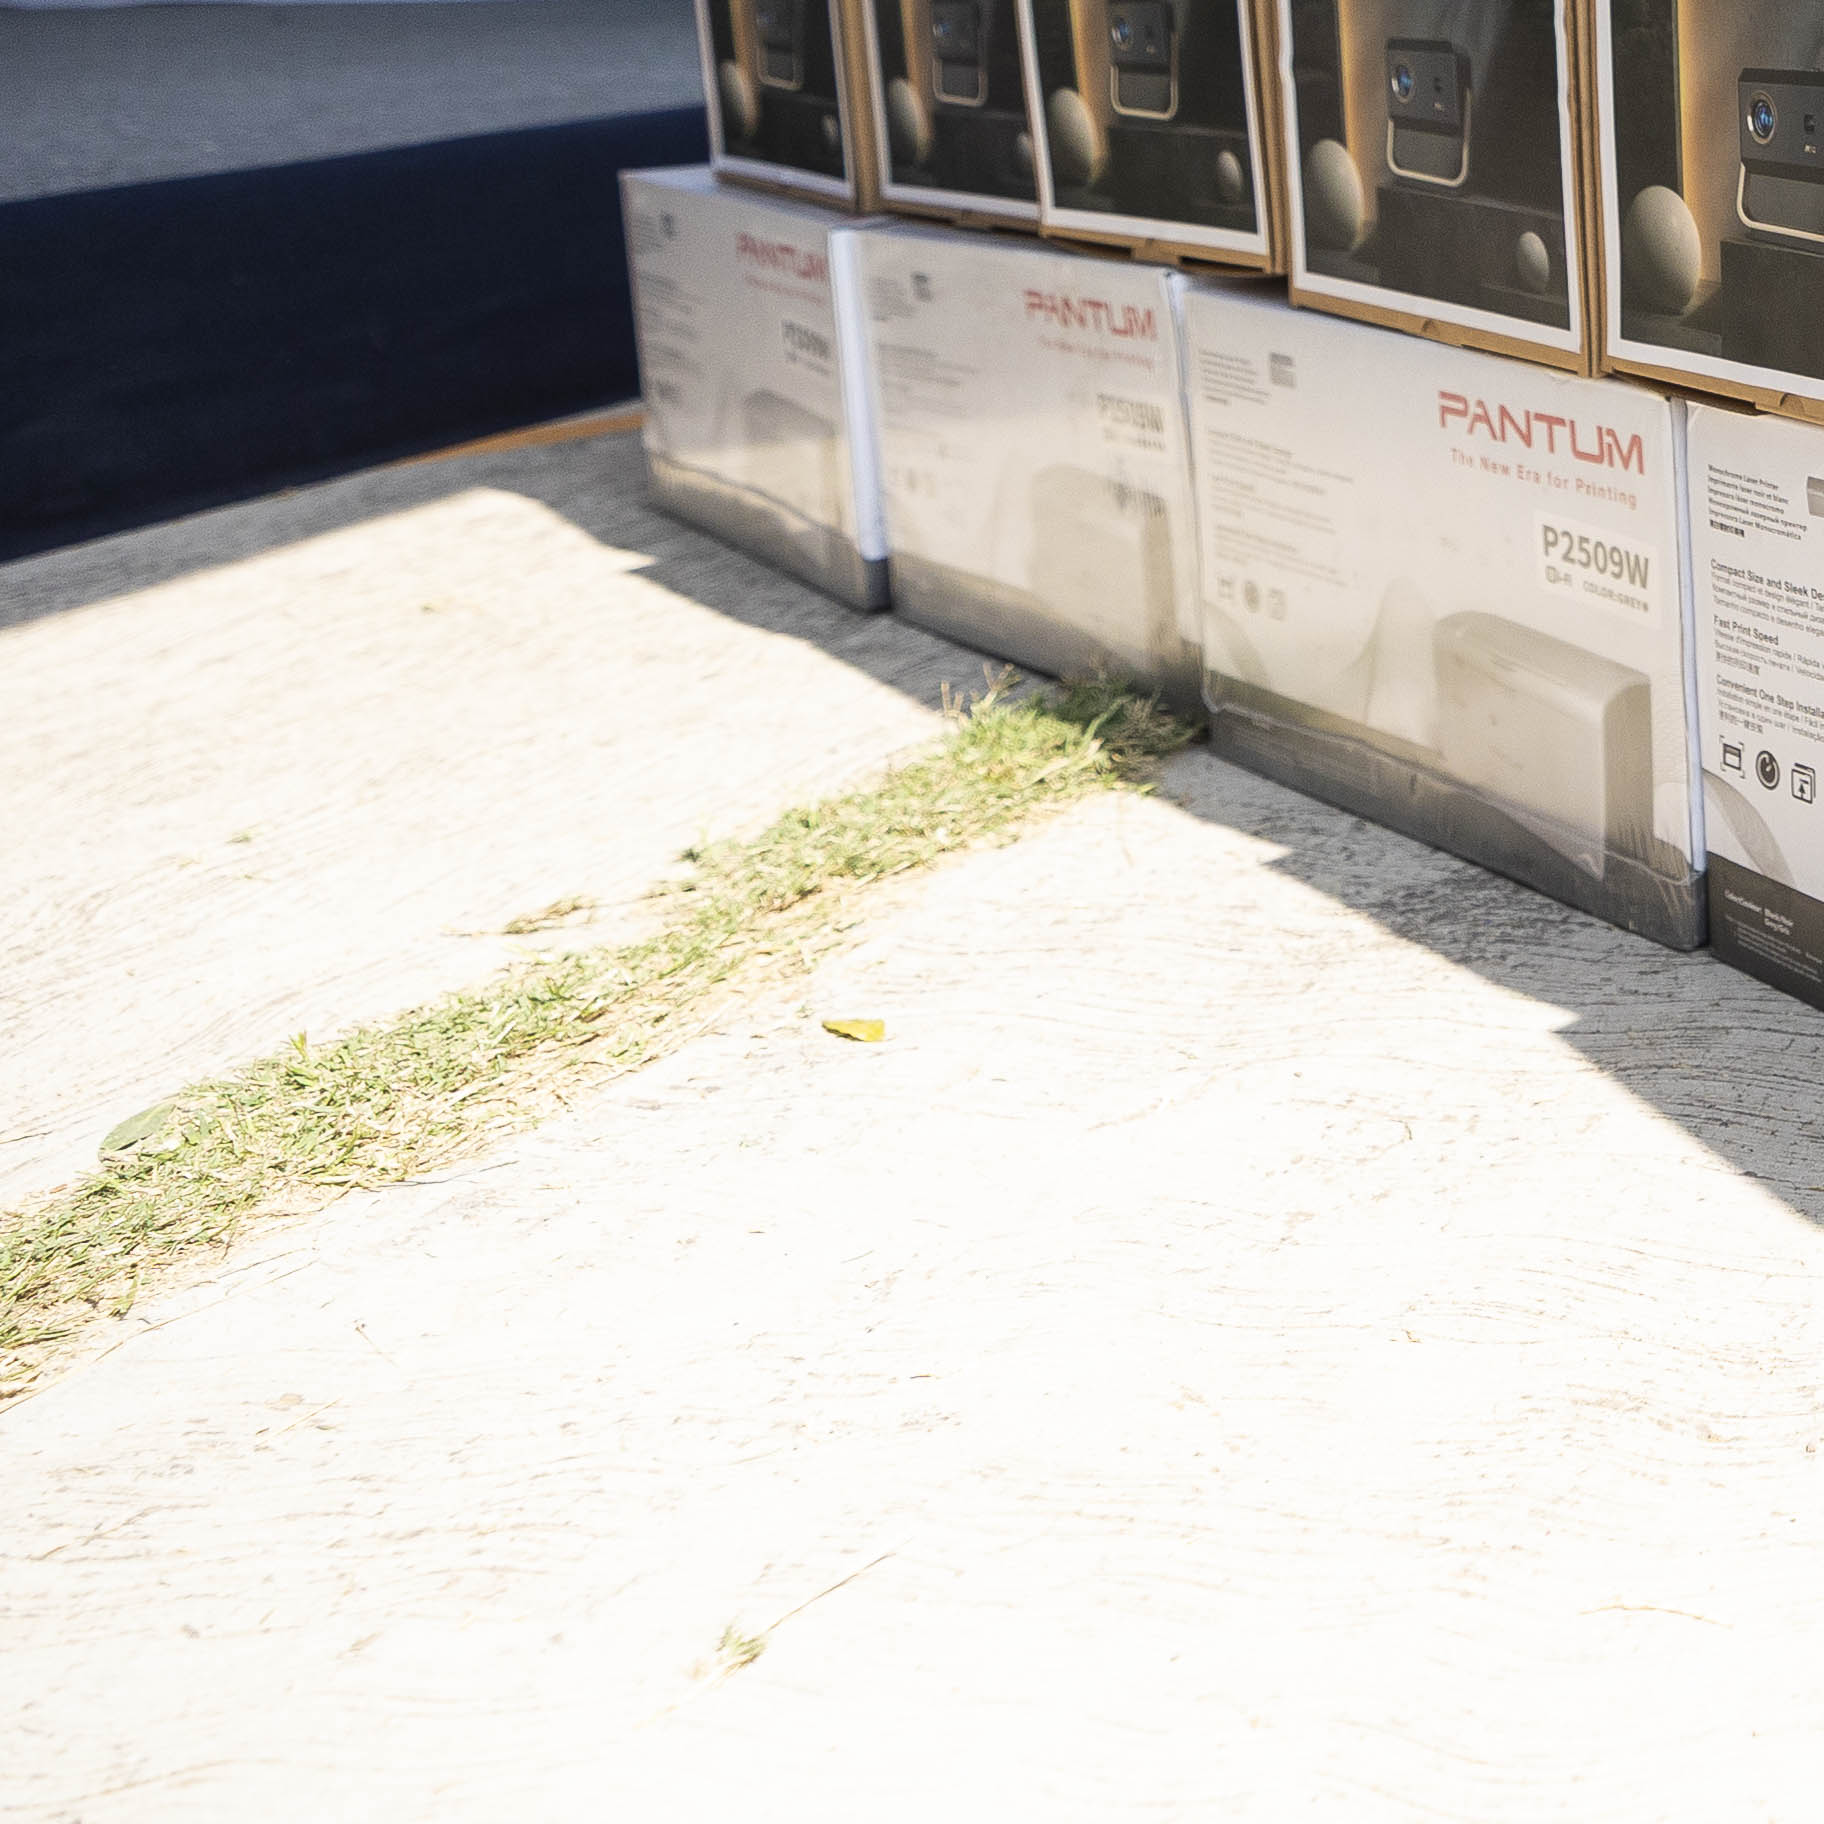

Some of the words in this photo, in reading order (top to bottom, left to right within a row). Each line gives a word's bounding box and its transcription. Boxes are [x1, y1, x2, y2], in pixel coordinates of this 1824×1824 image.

[1437, 391, 1645, 475] PANTUM
[1451, 448, 1473, 467] The
[1480, 455, 1509, 476] New
[1517, 465, 1542, 485] Era
[1547, 472, 1569, 491] for
[1575, 478, 1637, 509] Printing
[1542, 524, 1649, 589] P2509W
[1711, 559, 1745, 578] Compact
[1748, 570, 1763, 584] Size
[1766, 578, 1782, 590] and
[1784, 582, 1808, 596] Sleek
[1714, 615, 1730, 627] Fast
[1733, 621, 1751, 634] Print
[1753, 628, 1778, 645] Speed
[1717, 675, 1757, 698] Convenient
[1760, 689, 1774, 703] One
[1777, 695, 1794, 710] Step
